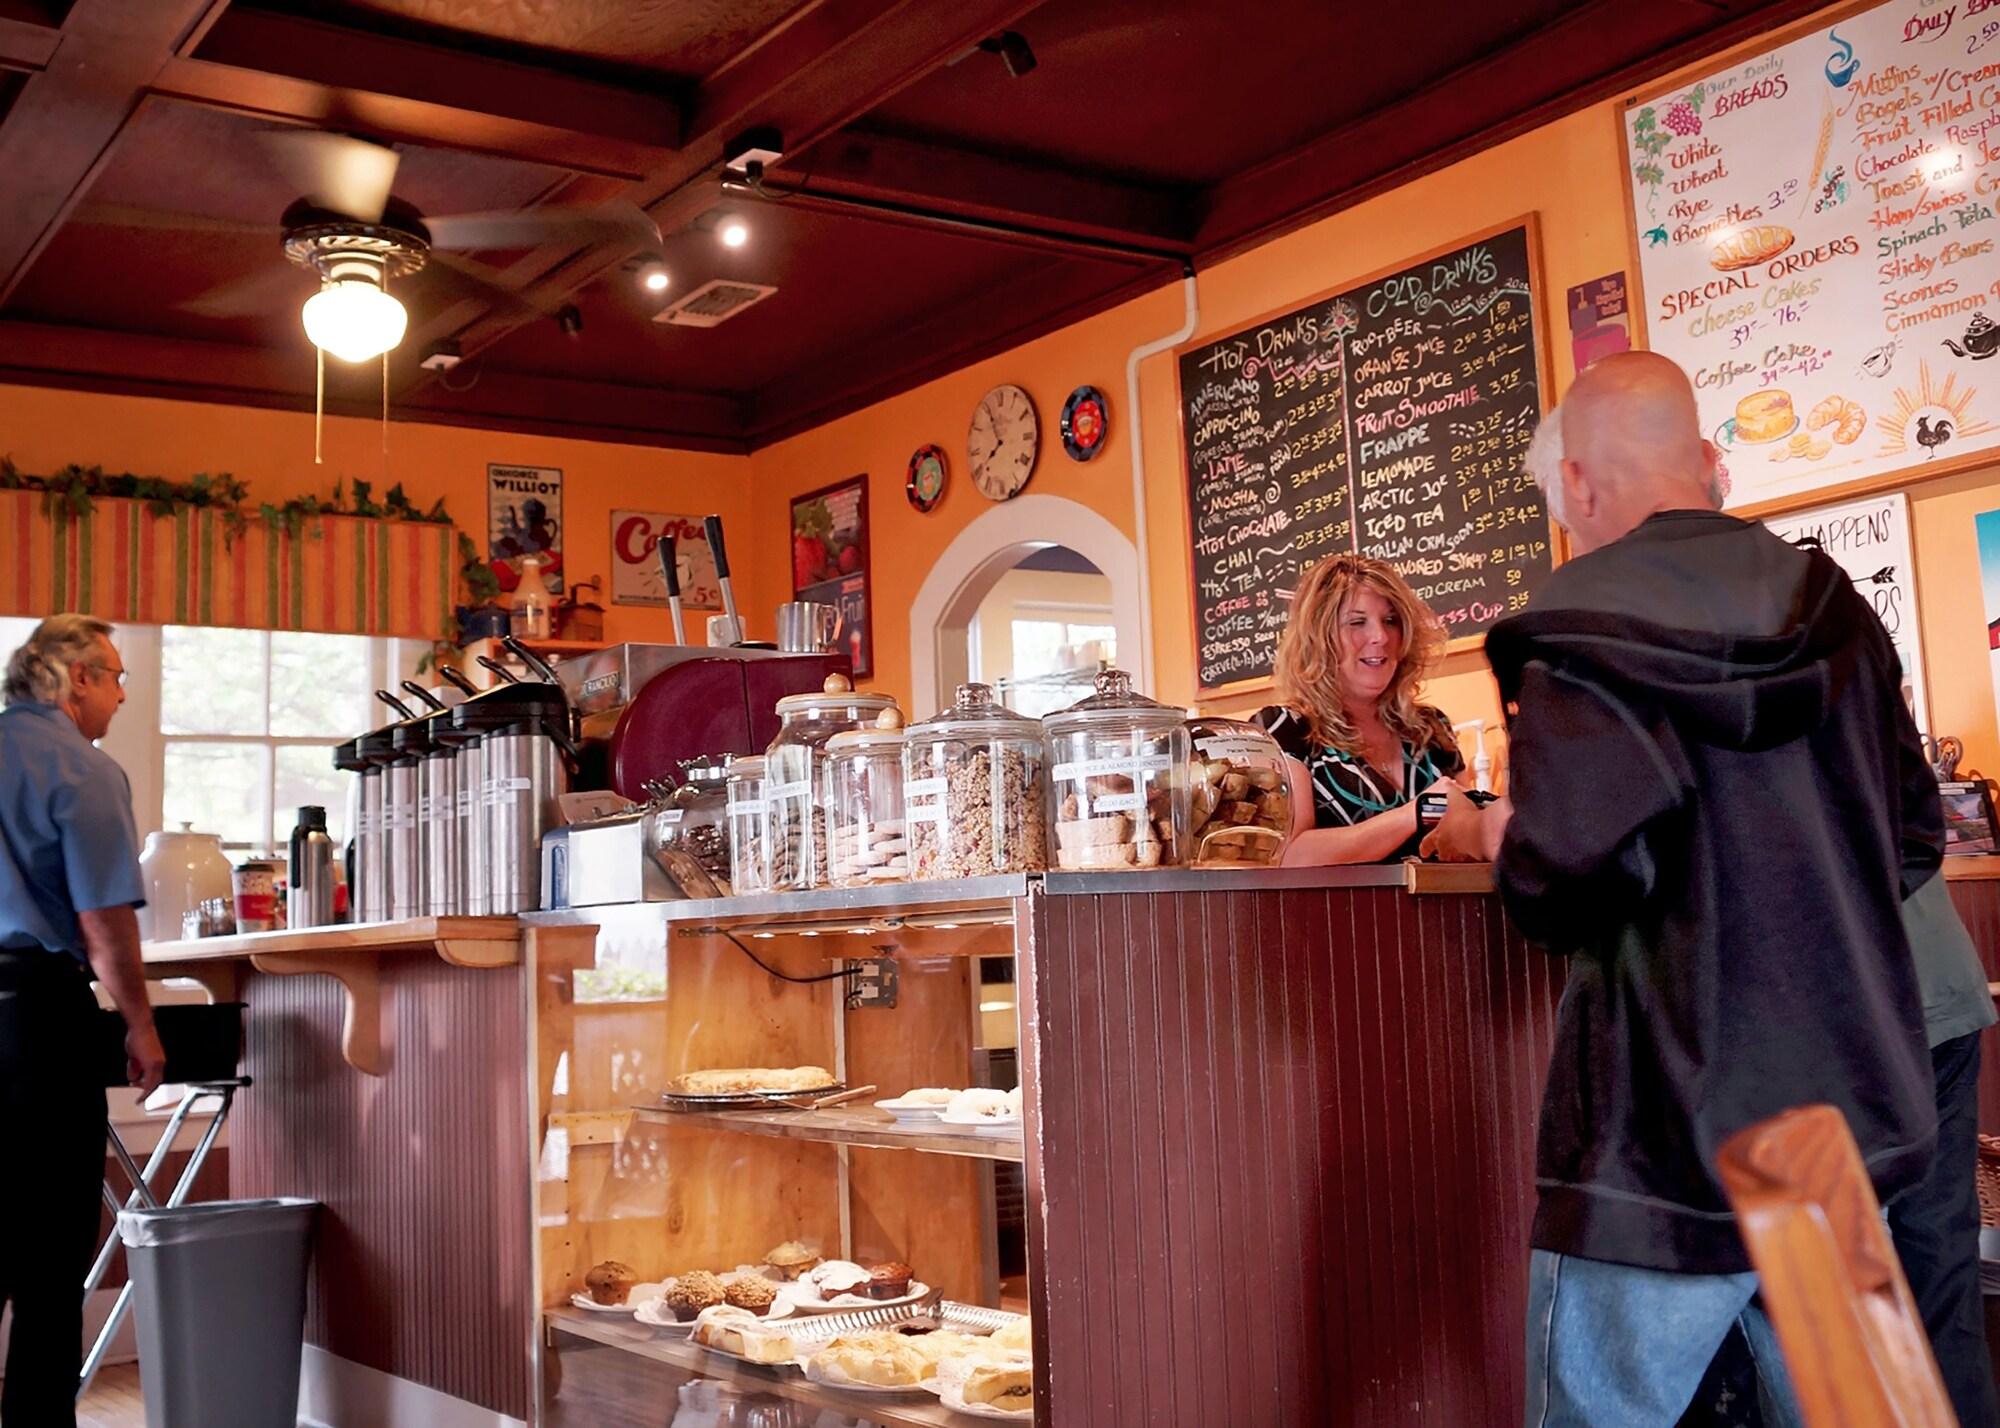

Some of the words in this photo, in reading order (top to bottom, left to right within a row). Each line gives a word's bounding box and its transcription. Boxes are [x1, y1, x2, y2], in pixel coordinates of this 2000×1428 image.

[1659, 270, 1759, 321] SPECIAL
[1768, 235, 1860, 280] ORDERS
[1885, 293, 1988, 333] Cinnamon
[1355, 377, 1413, 408] CARROT
[1360, 422, 1431, 465] FRAPPE
[1361, 454, 1436, 489] LEMONADE
[1358, 486, 1415, 513] ARCTIC
[1411, 503, 1445, 529] TEA
[1800, 508, 1892, 555] HAPPENS
[1214, 548, 1253, 575] CHAI
[1231, 564, 1263, 594] TEA
[1204, 595, 1251, 624] COFFEE
[1204, 613, 1254, 641] COFFEE
